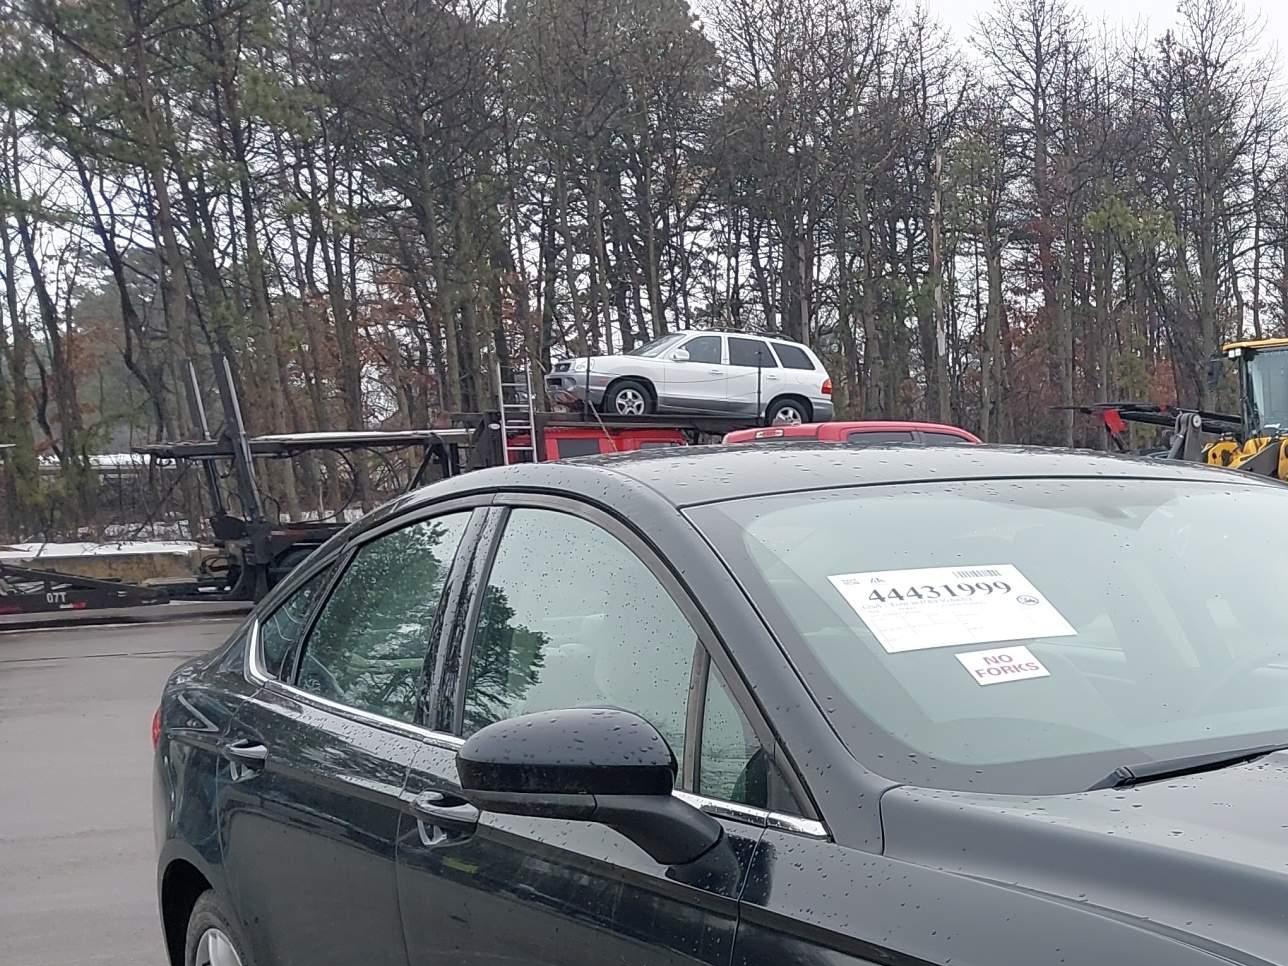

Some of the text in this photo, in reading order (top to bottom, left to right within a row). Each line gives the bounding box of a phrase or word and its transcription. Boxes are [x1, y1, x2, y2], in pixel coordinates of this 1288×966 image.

[868, 581, 1012, 603] 44431999
[983, 653, 1014, 666] NO
[975, 662, 1040, 679] FORKS
